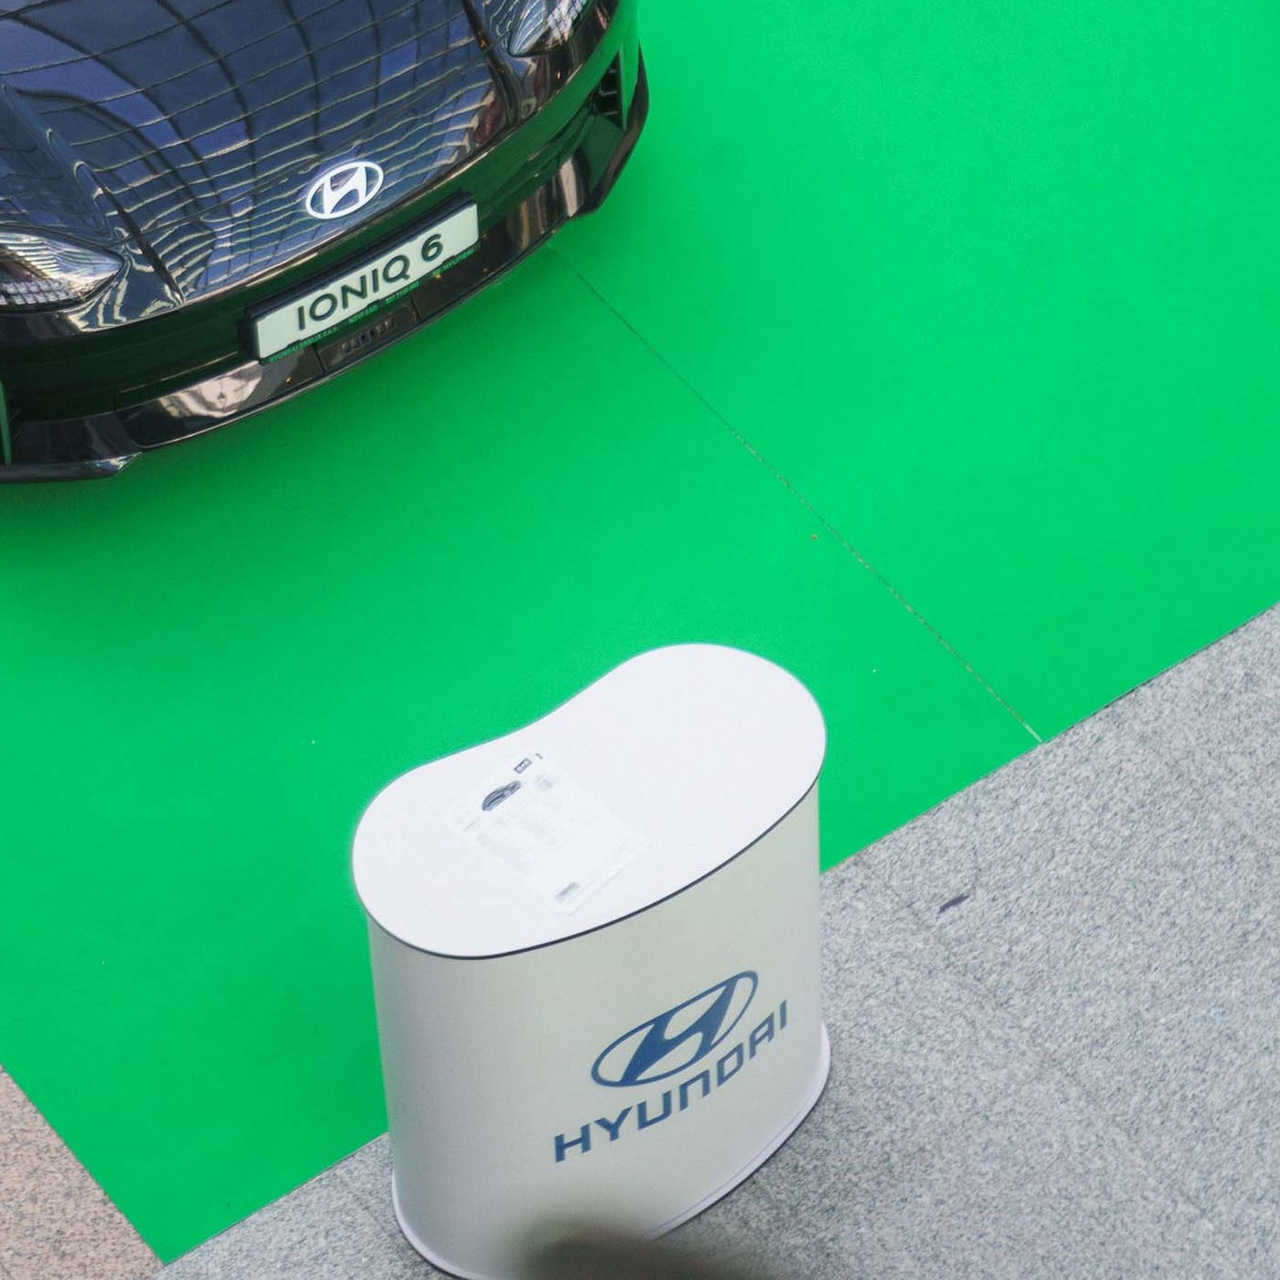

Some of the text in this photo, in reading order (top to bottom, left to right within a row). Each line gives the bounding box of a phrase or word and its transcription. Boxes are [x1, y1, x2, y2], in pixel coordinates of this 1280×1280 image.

[297, 254, 411, 331] IONIQ
[420, 233, 444, 263] 6
[553, 1000, 788, 1163] HYUNDAI
